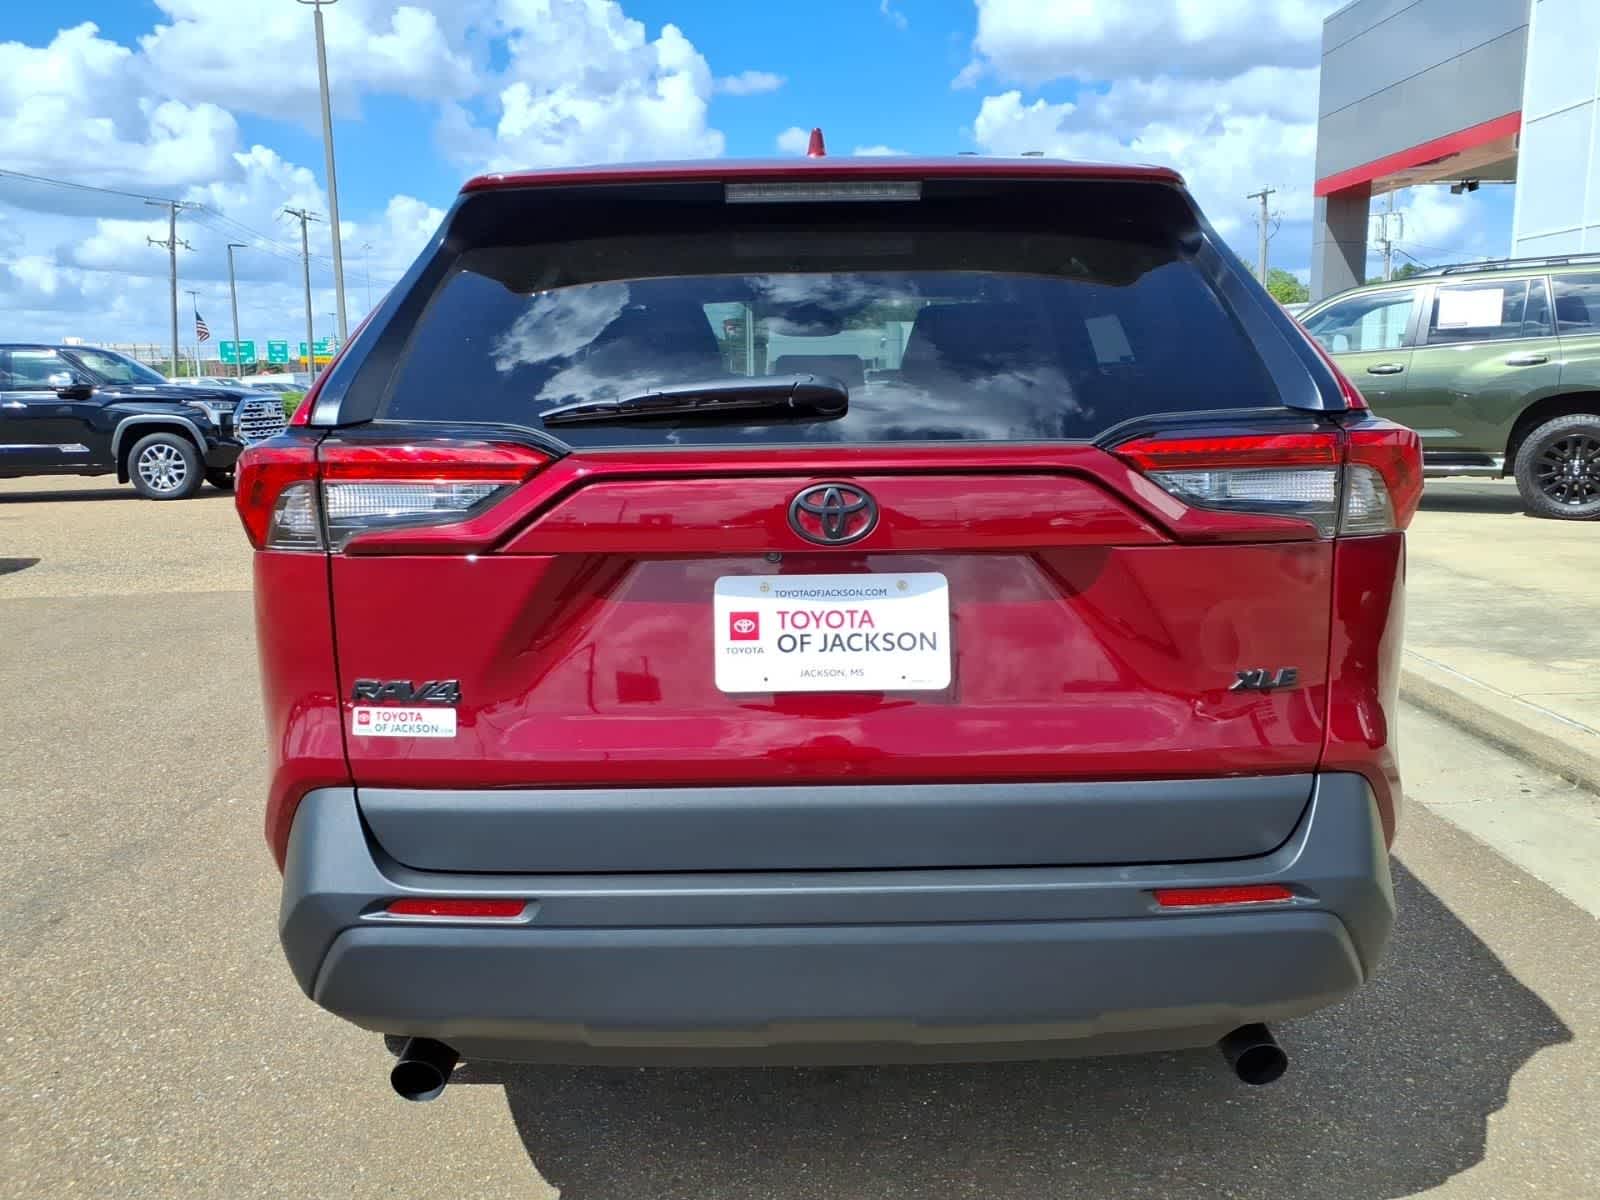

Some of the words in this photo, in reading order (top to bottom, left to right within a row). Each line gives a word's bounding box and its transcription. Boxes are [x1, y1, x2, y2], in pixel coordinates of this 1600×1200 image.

[775, 588, 888, 598] TOYOTAOFJACKSON.COM
[776, 610, 875, 630] TOYOTA
[777, 633, 812, 653] OF
[818, 632, 937, 653] JACKSON
[726, 647, 765, 655] TOYOTA
[799, 668, 848, 678] JACKSON,
[850, 668, 865, 677] MS
[1229, 667, 1297, 691] XLE
[352, 680, 461, 702] RAV4
[376, 711, 423, 722] TOYOTA
[374, 723, 390, 733] OF
